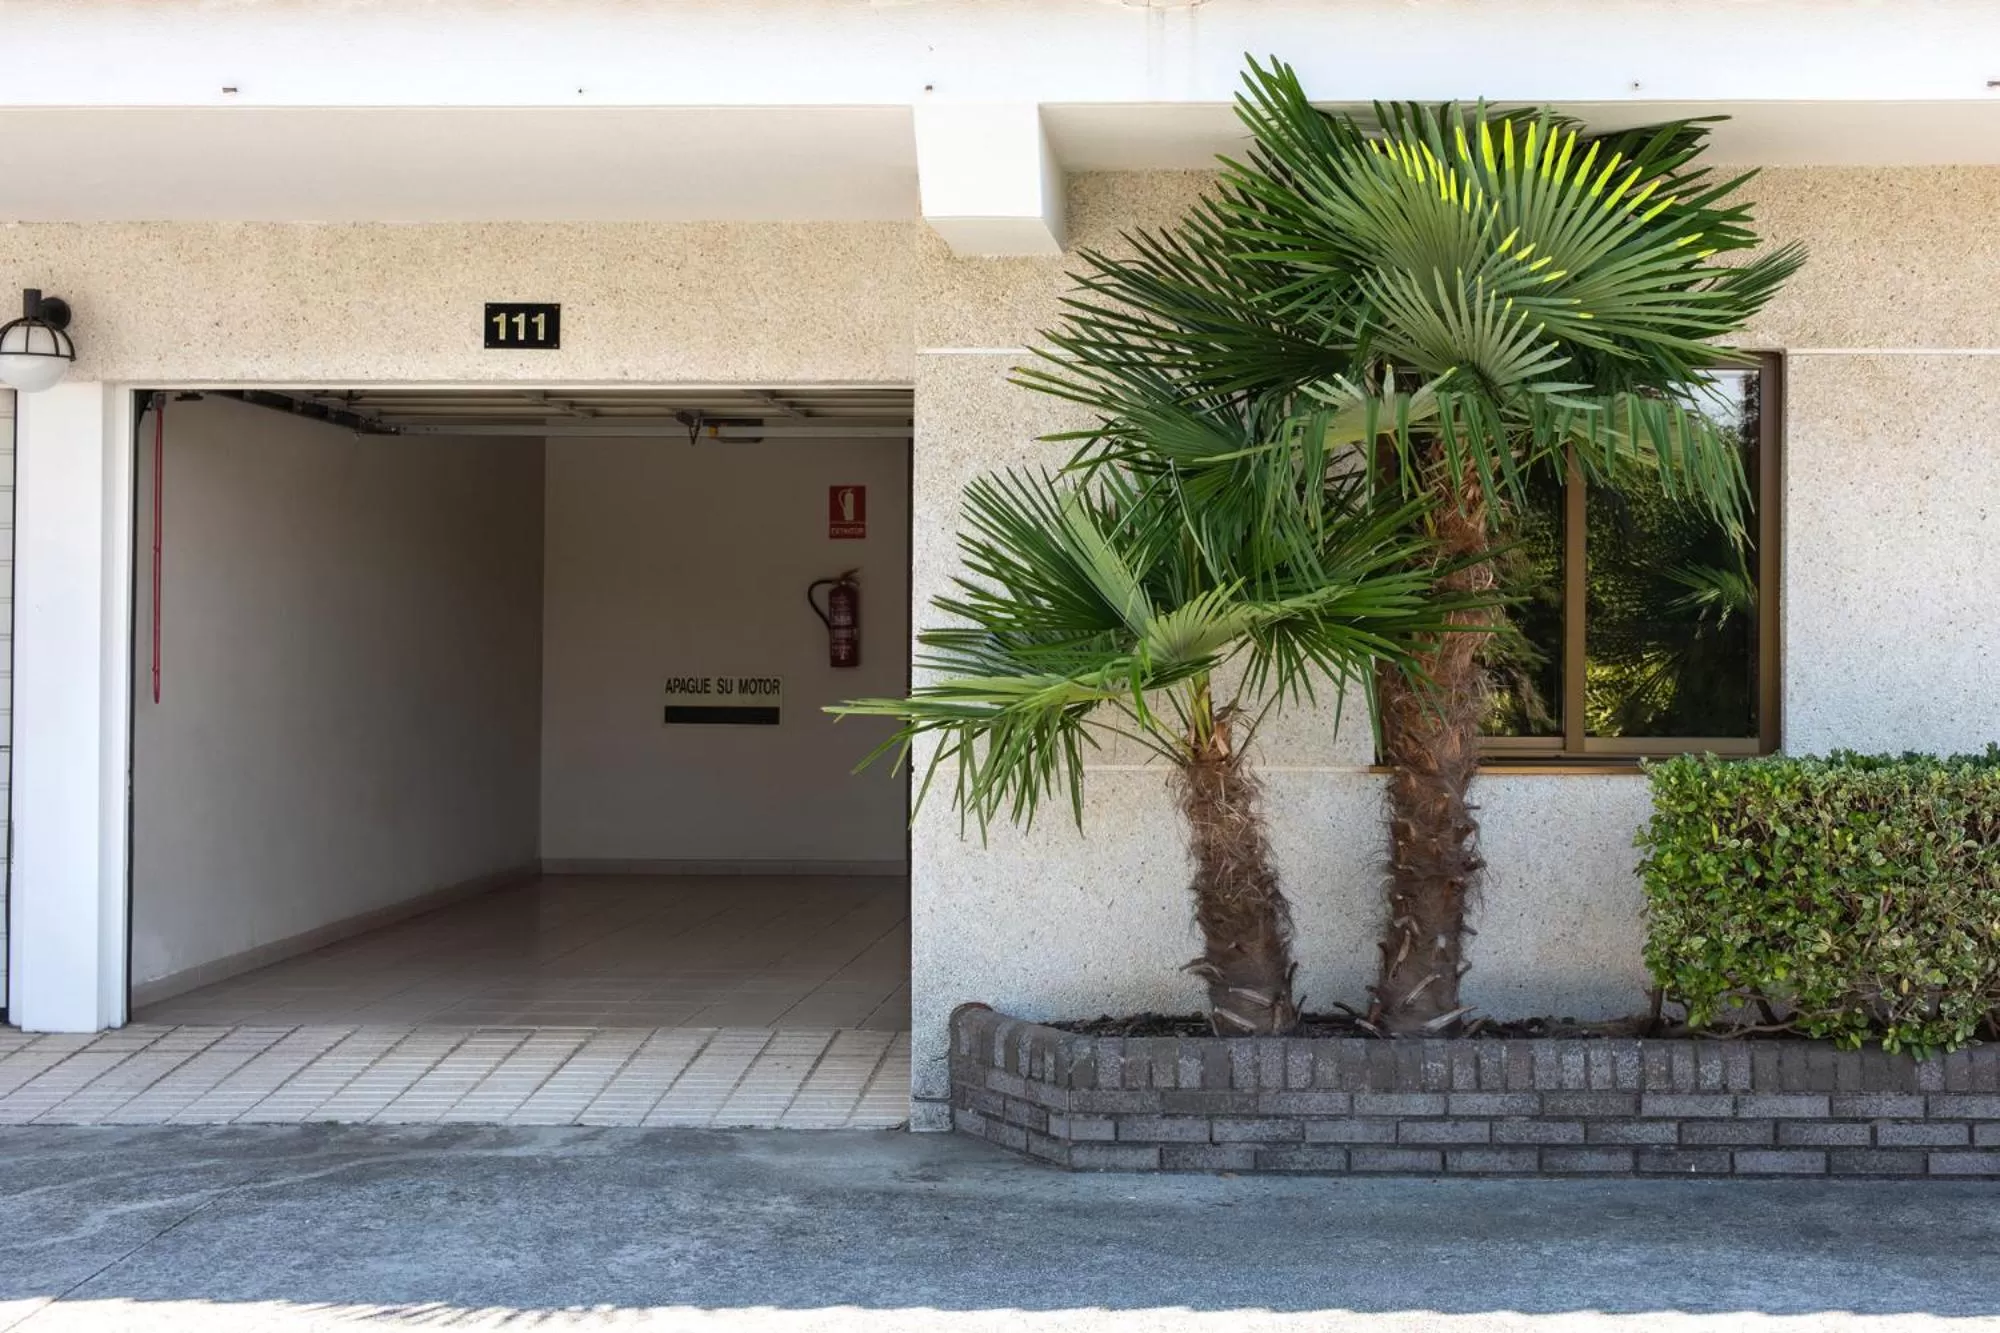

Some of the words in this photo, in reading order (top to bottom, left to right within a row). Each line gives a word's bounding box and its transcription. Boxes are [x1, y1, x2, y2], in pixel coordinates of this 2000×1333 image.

[492, 312, 545, 341] 111
[665, 677, 712, 695] APAGUE
[716, 677, 734, 695] SU
[738, 678, 781, 695] MOTOR
